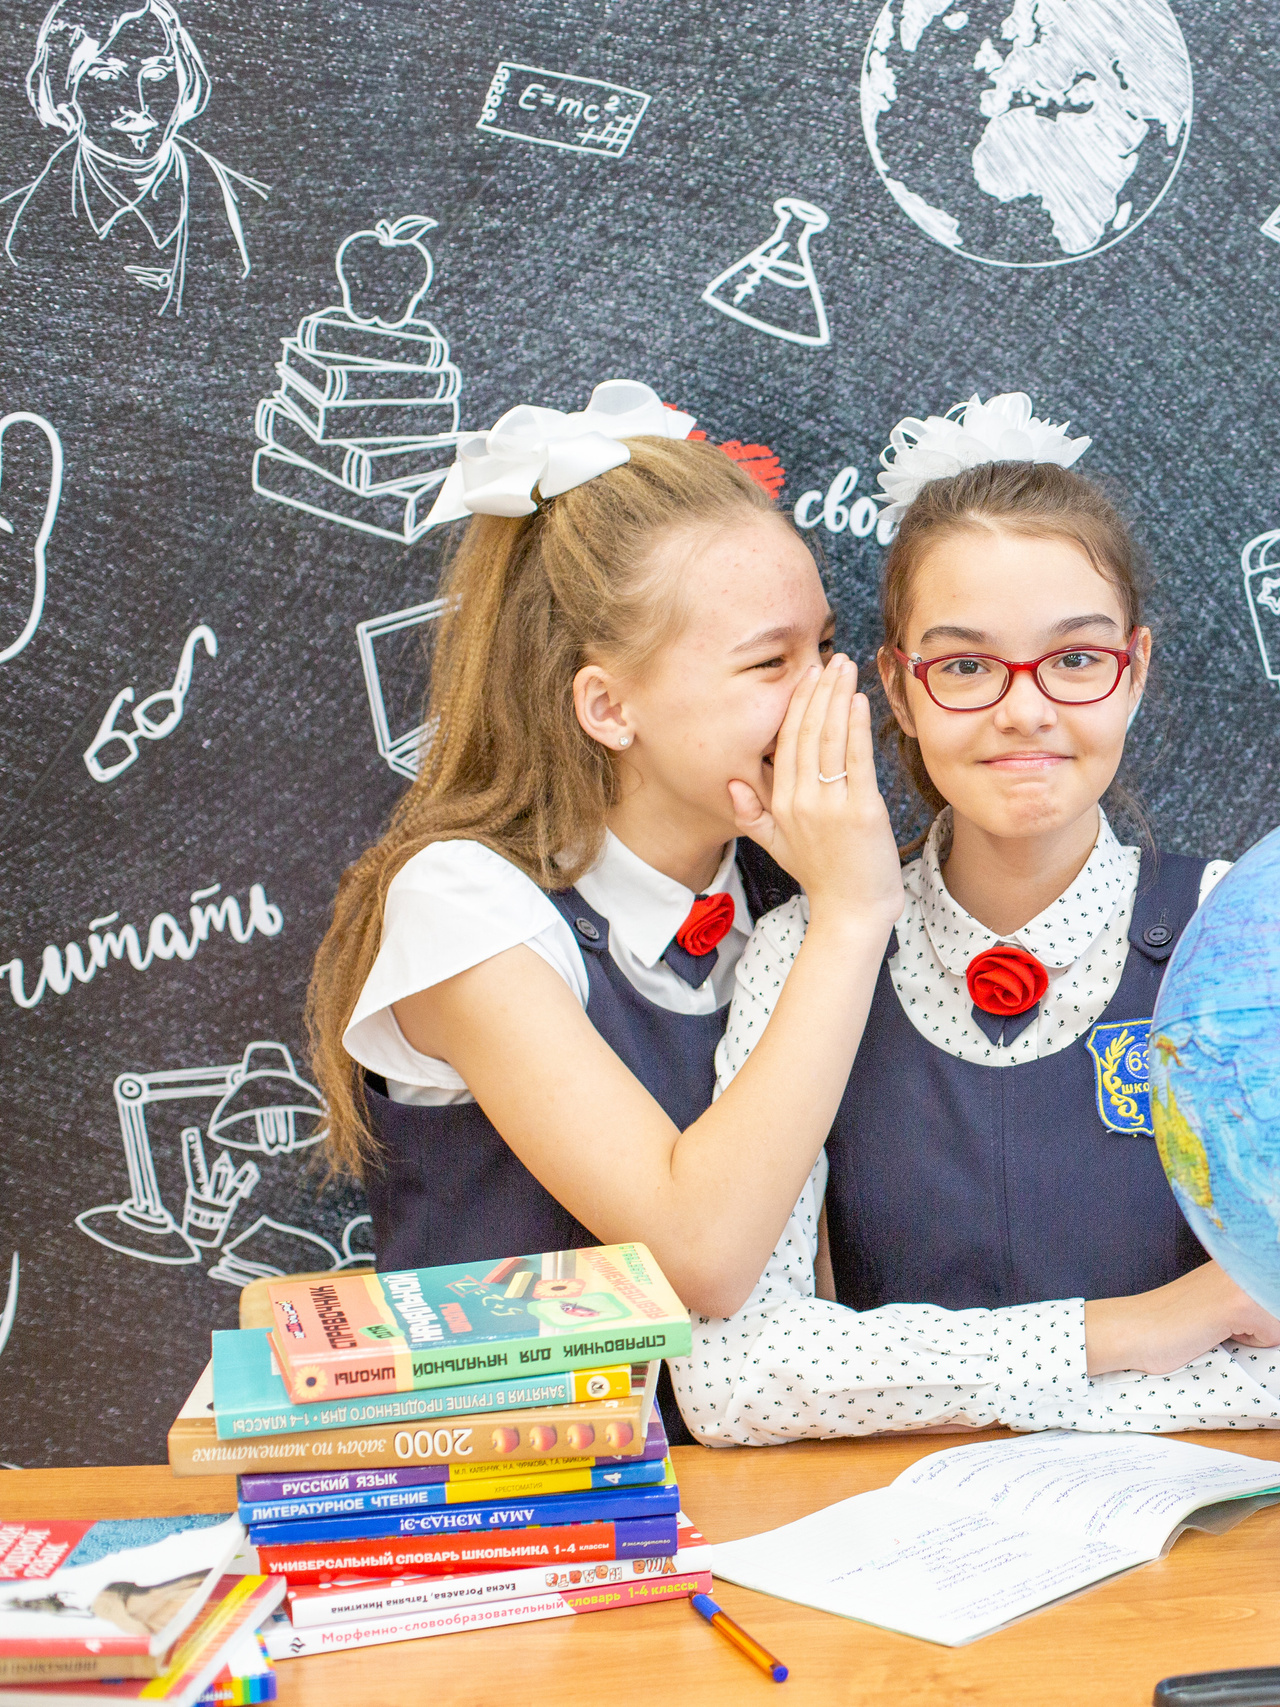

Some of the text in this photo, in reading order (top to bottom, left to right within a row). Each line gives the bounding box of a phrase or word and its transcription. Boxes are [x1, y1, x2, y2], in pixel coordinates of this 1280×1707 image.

[309, 1284, 358, 1350] СПРАВОЧНИК
[382, 1272, 444, 1343] НАЧАЛЬНОЙ
[335, 1334, 667, 1385] СПРАВОЧНИК ДЛЯ НАЧАЛЬНОЙ ШКОЛЫ
[446, 1392, 493, 1411] ГРУППЕ
[496, 1390, 506, 1405] В
[508, 1384, 566, 1404] ЗАНЯТИЯ
[320, 1406, 347, 1424] ДНЯ
[350, 1397, 443, 1421] ПРОДЛЕННОГО
[232, 1415, 287, 1433] КЛАССЫ
[192, 1428, 473, 1462] 2000 задач по математике
[282, 1473, 397, 1495] РУССКИЙ ЯЗЫК
[603, 1471, 622, 1484] 4
[494, 1482, 543, 1494] ХРЕСТОМАТИЯ
[252, 1491, 428, 1521] ЛИТЕРАТУРНОЕ ЧТЕНИЕ
[400, 1509, 535, 1531] АМАР МЭНДЭ-Э!
[269, 1541, 609, 1573] УНИВЕРСАЛЬНЫЙ СЛОВАРЬ ШКОЛЬНИКА 1-4 классы
[633, 1556, 677, 1574] Ума
[486, 1583, 516, 1593] Елена
[331, 1600, 383, 1614] Никитина
[386, 1595, 428, 1606] Татьяна
[321, 1580, 698, 1644] Морфемно-словообразовательный словарь 1-4 классы
